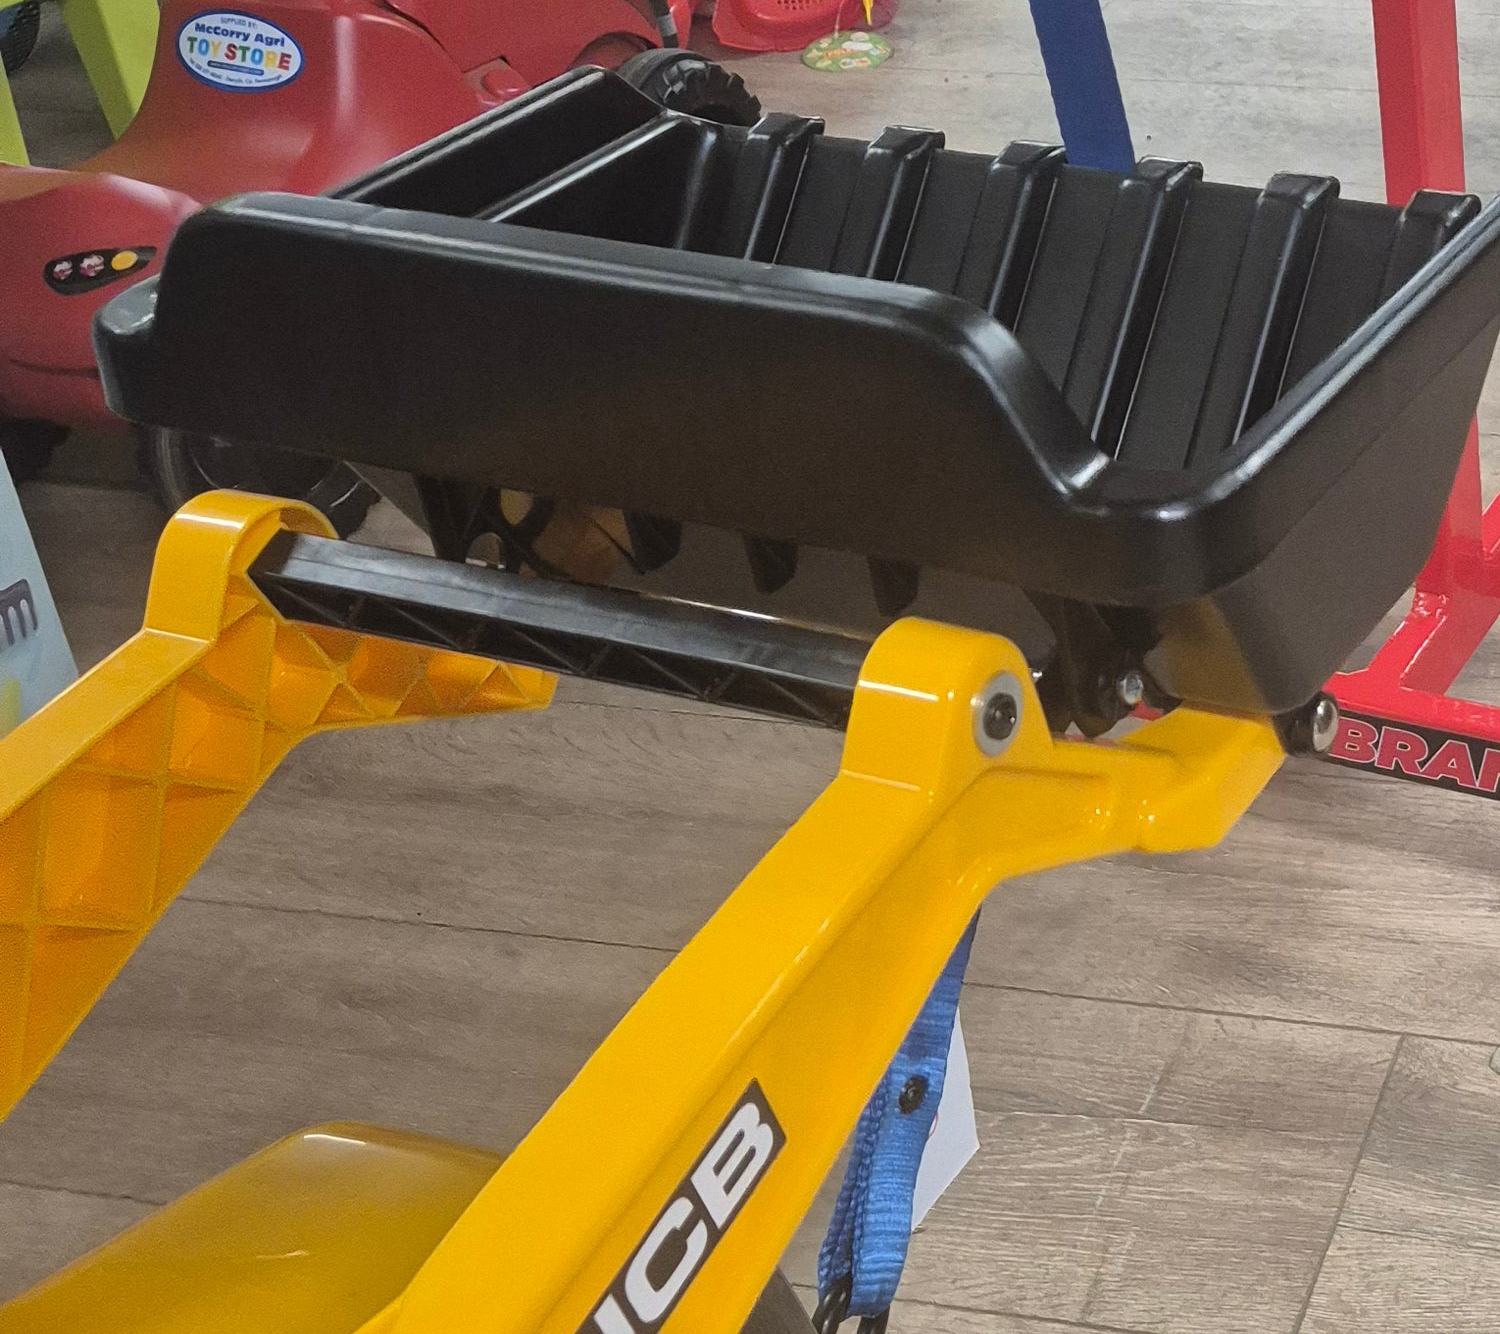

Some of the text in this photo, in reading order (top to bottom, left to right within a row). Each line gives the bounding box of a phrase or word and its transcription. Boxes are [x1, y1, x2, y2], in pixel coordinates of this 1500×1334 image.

[194, 22, 286, 48] McCorry Agri
[186, 36, 222, 60] TOY
[224, 43, 293, 71] STORE
